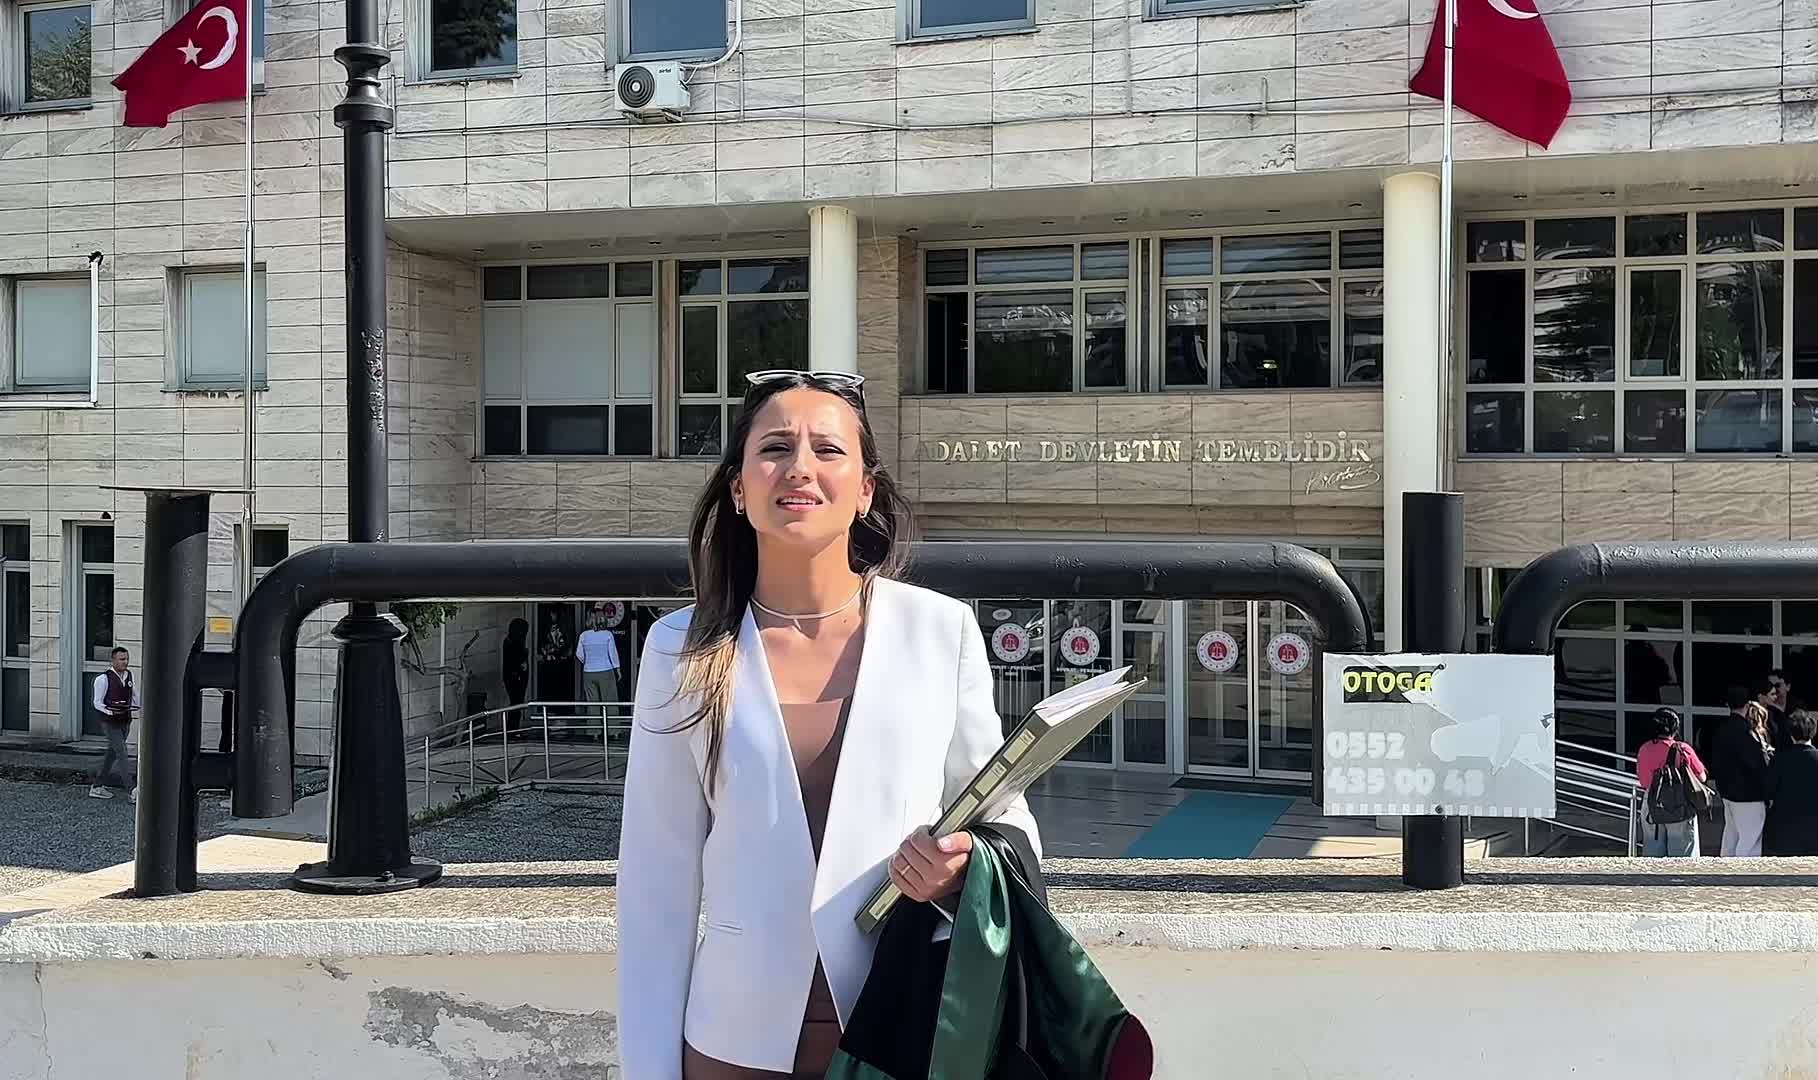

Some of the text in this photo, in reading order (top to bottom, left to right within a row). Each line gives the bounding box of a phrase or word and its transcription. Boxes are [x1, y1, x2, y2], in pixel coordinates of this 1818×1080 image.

[1039, 433, 1182, 462] DEVLETİN
[1198, 431, 1371, 462] TEMELİDİR
[1326, 731, 1406, 760] 0552
[1327, 767, 1385, 795] 435
[1395, 767, 1436, 796] 00
